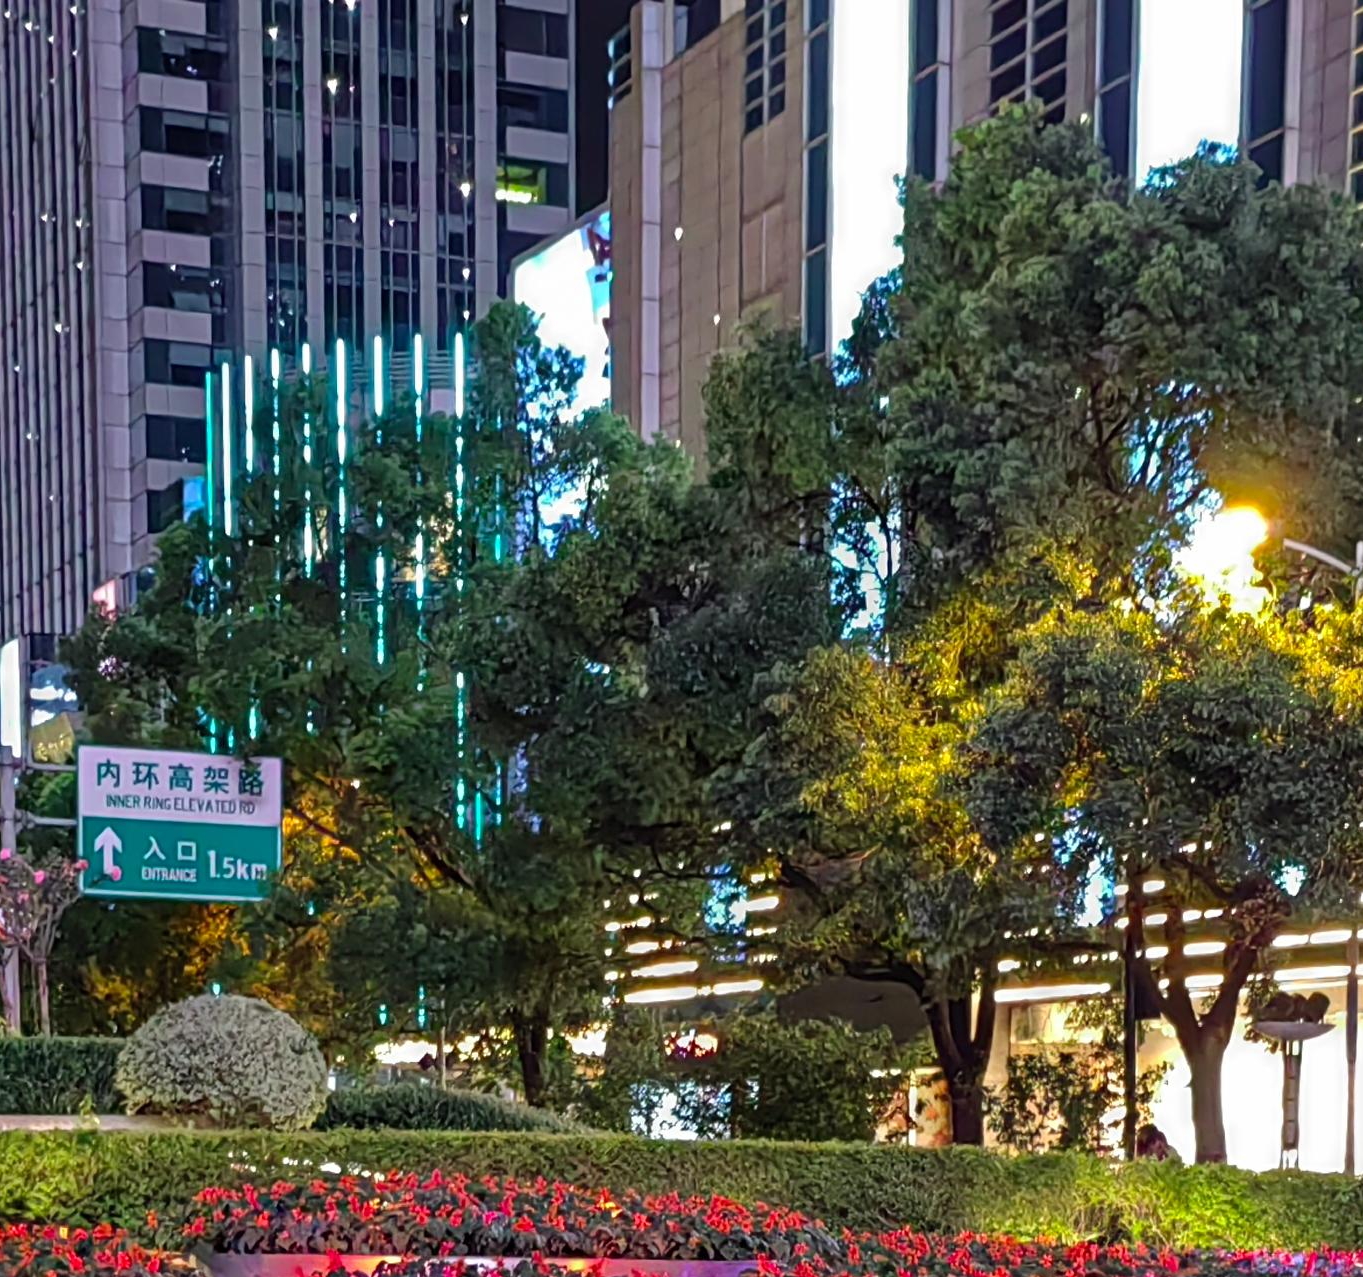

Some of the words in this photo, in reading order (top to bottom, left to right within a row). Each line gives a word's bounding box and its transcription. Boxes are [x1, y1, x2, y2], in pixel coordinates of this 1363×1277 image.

[96, 758, 264, 797] 内环高架路
[106, 794, 141, 808] INNER
[143, 795, 171, 811] RING
[173, 797, 236, 814] ELEVATED
[239, 801, 256, 815] RD
[143, 836, 197, 861] 入口
[141, 865, 198, 883] ENTRANCE
[207, 850, 268, 881] 1.5km
